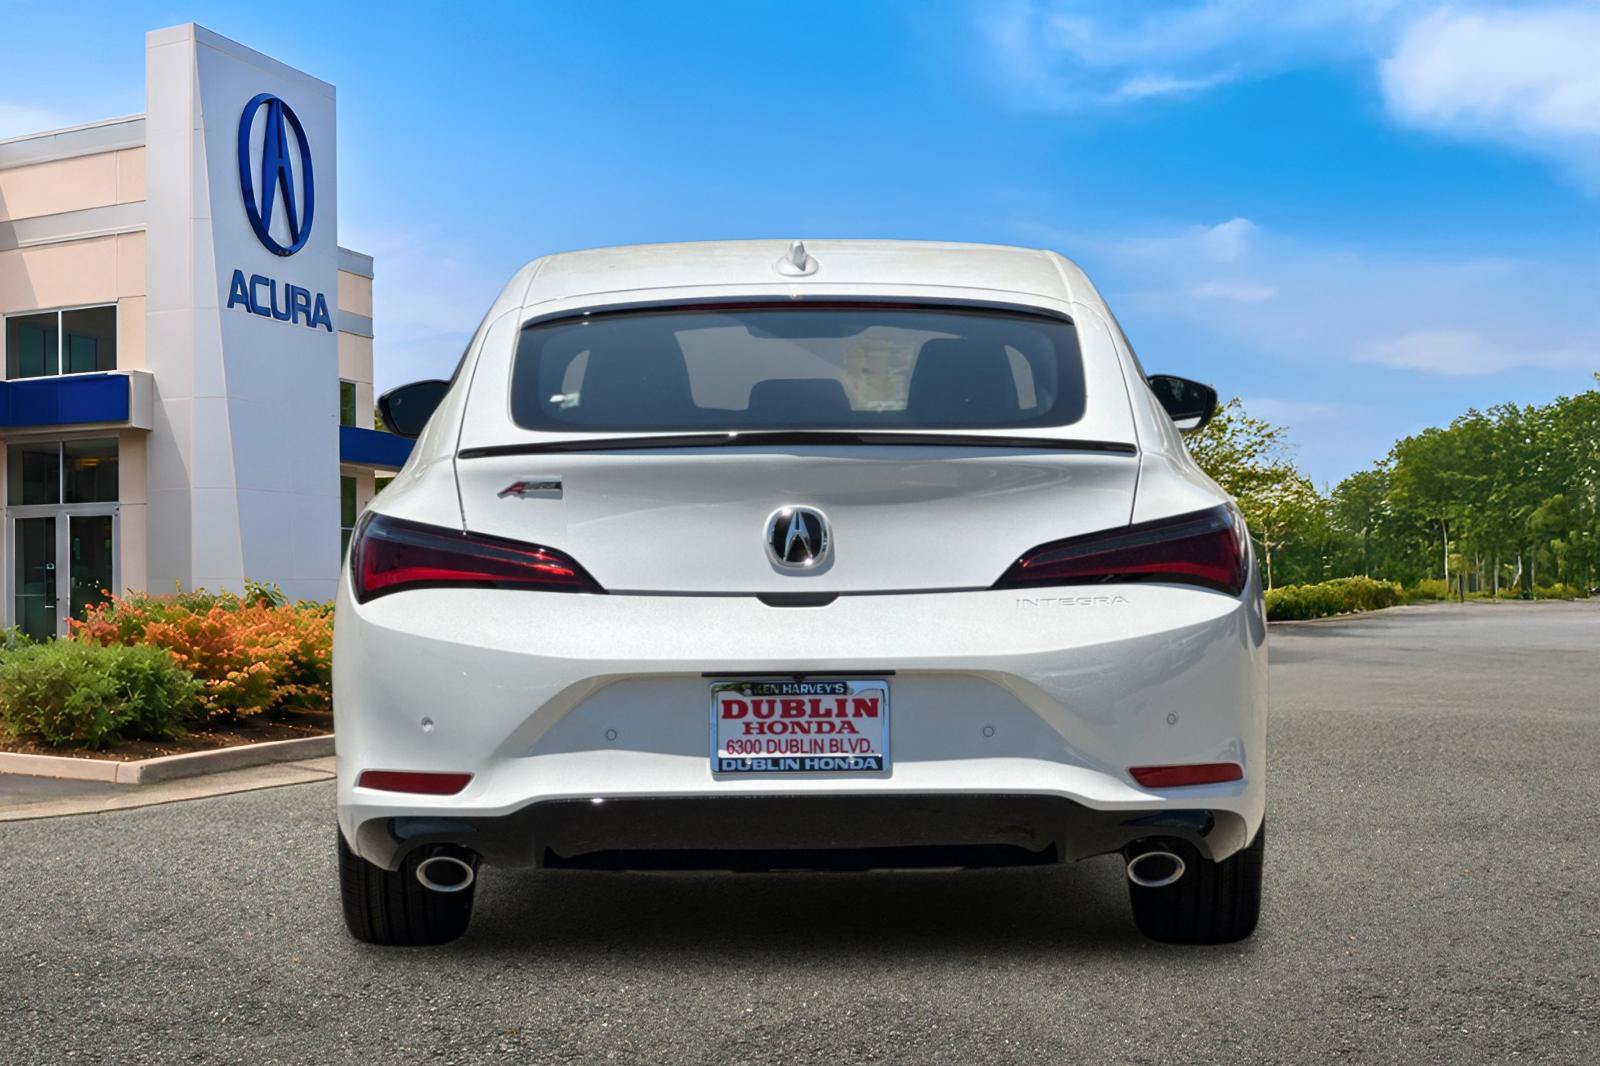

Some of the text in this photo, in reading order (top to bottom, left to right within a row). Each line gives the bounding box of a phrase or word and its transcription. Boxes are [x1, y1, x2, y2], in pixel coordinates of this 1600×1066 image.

[227, 269, 333, 332] ACURA
[1016, 596, 1129, 608] INTEGRA
[782, 683, 845, 694] HARVEY'S
[721, 698, 879, 719] DUBLIN
[742, 721, 859, 735] HONDA
[726, 738, 875, 755] 6300 DUBLIN BLVD.
[722, 758, 879, 770] DUBLIN HONDA
